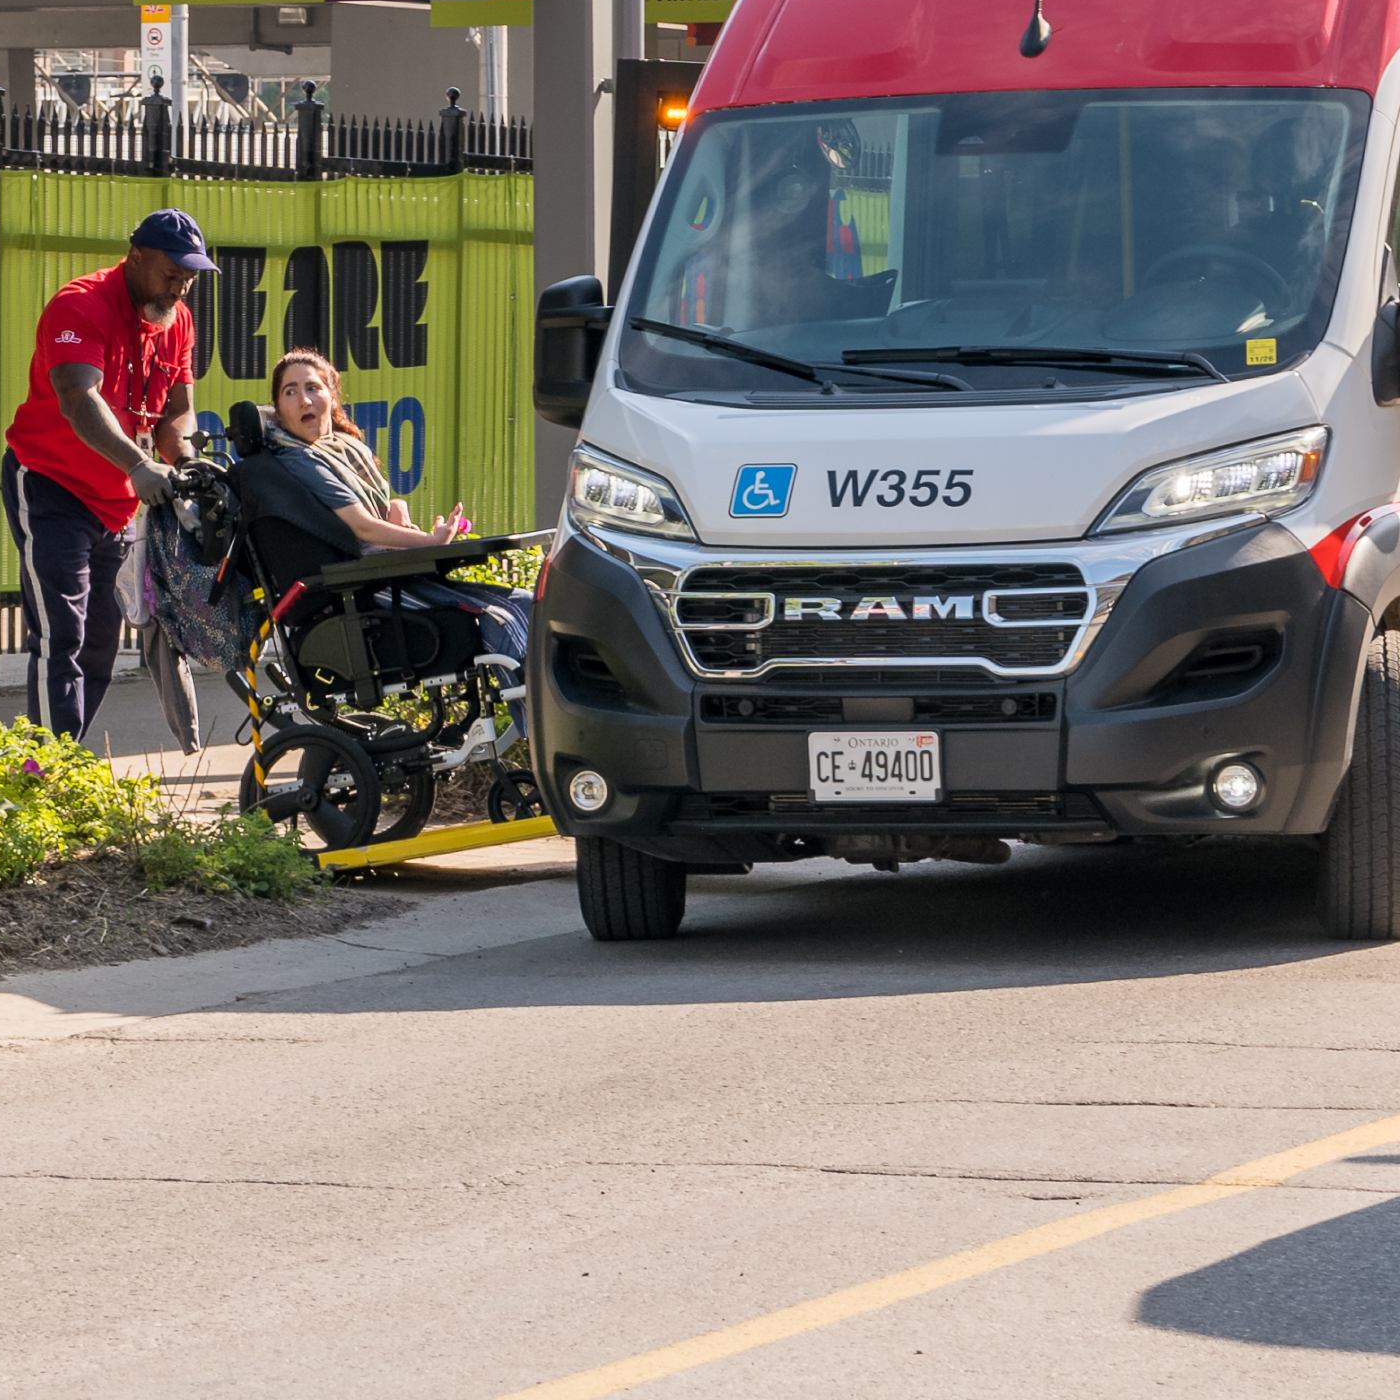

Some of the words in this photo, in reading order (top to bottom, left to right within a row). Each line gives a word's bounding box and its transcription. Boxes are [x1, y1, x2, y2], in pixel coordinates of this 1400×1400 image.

[283, 239, 429, 372] ARE
[827, 468, 974, 508] W355
[785, 596, 975, 620] RAM
[848, 736, 899, 749] ONTARIO
[816, 750, 845, 784] CE
[860, 749, 934, 783] 49400
